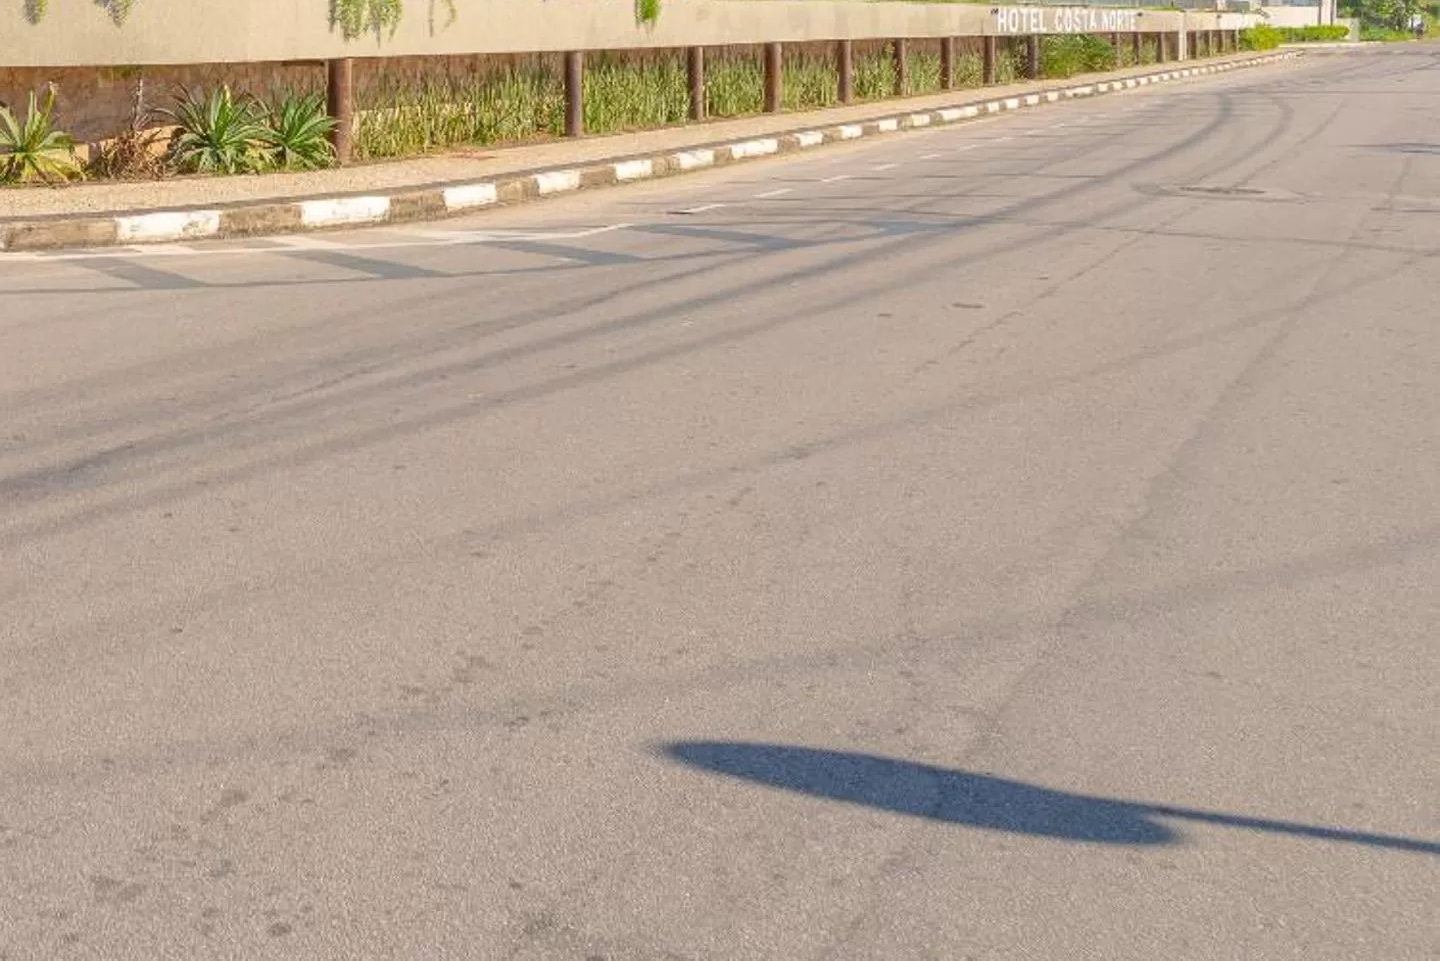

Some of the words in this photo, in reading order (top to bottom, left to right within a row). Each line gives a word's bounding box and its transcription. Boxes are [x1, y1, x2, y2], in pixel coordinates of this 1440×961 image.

[997, 7, 1046, 32] HOTEL
[1054, 8, 1097, 32] COSTA
[1101, 10, 1136, 31] NORTE
